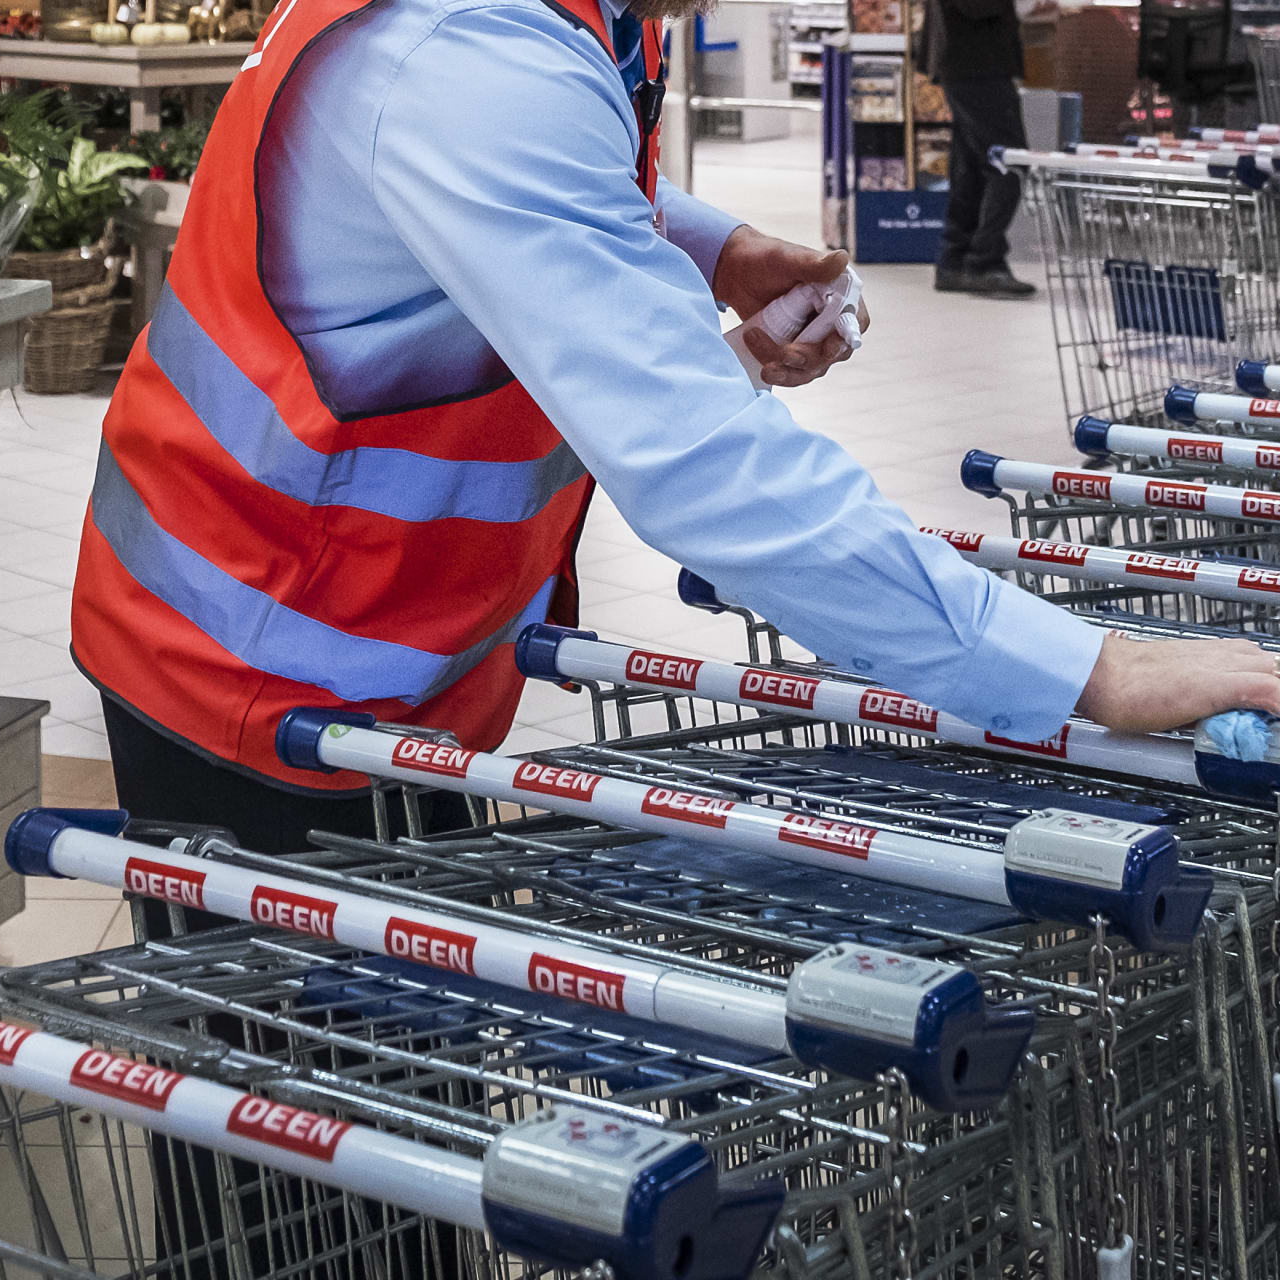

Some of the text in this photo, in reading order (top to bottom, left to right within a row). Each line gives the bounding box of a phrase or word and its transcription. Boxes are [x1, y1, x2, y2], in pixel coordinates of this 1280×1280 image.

[1169, 445, 1219, 460] DEEN
[1056, 478, 1107, 497] DEEN
[1149, 486, 1203, 506] DEEN
[1024, 540, 1084, 558] DEEN
[1133, 555, 1198, 573] DEEN
[631, 656, 932, 723] DEEN DEEN DEEN
[399, 738, 870, 848] DEEN DEEN DEEN DEEN
[130, 869, 618, 1008] DEEN DEEN DEEN DEEN
[83, 1053, 172, 1095] DEEN
[240, 1100, 344, 1144] DEEN
